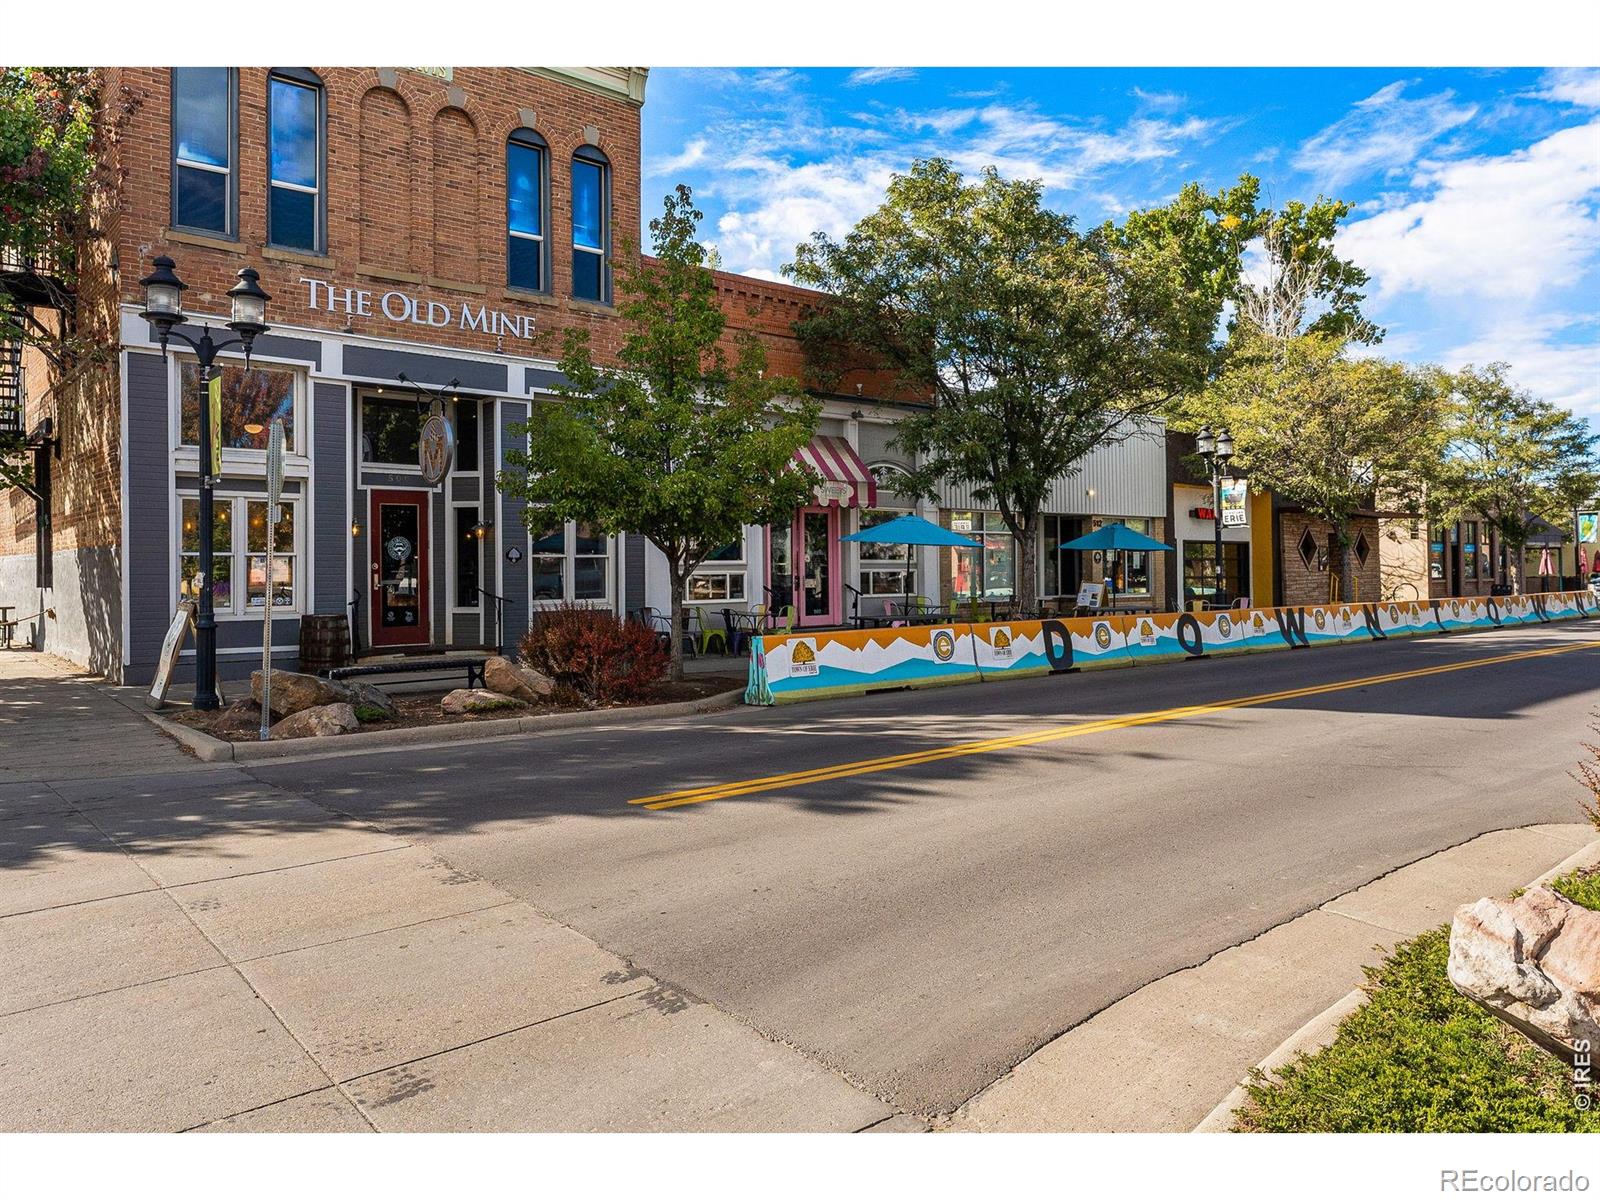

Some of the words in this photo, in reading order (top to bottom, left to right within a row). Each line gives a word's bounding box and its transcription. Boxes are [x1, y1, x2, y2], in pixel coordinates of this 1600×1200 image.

[299, 277, 372, 317] THE
[381, 291, 451, 327] OLD
[459, 302, 537, 339] MINE
[1224, 514, 1245, 523] ERIE
